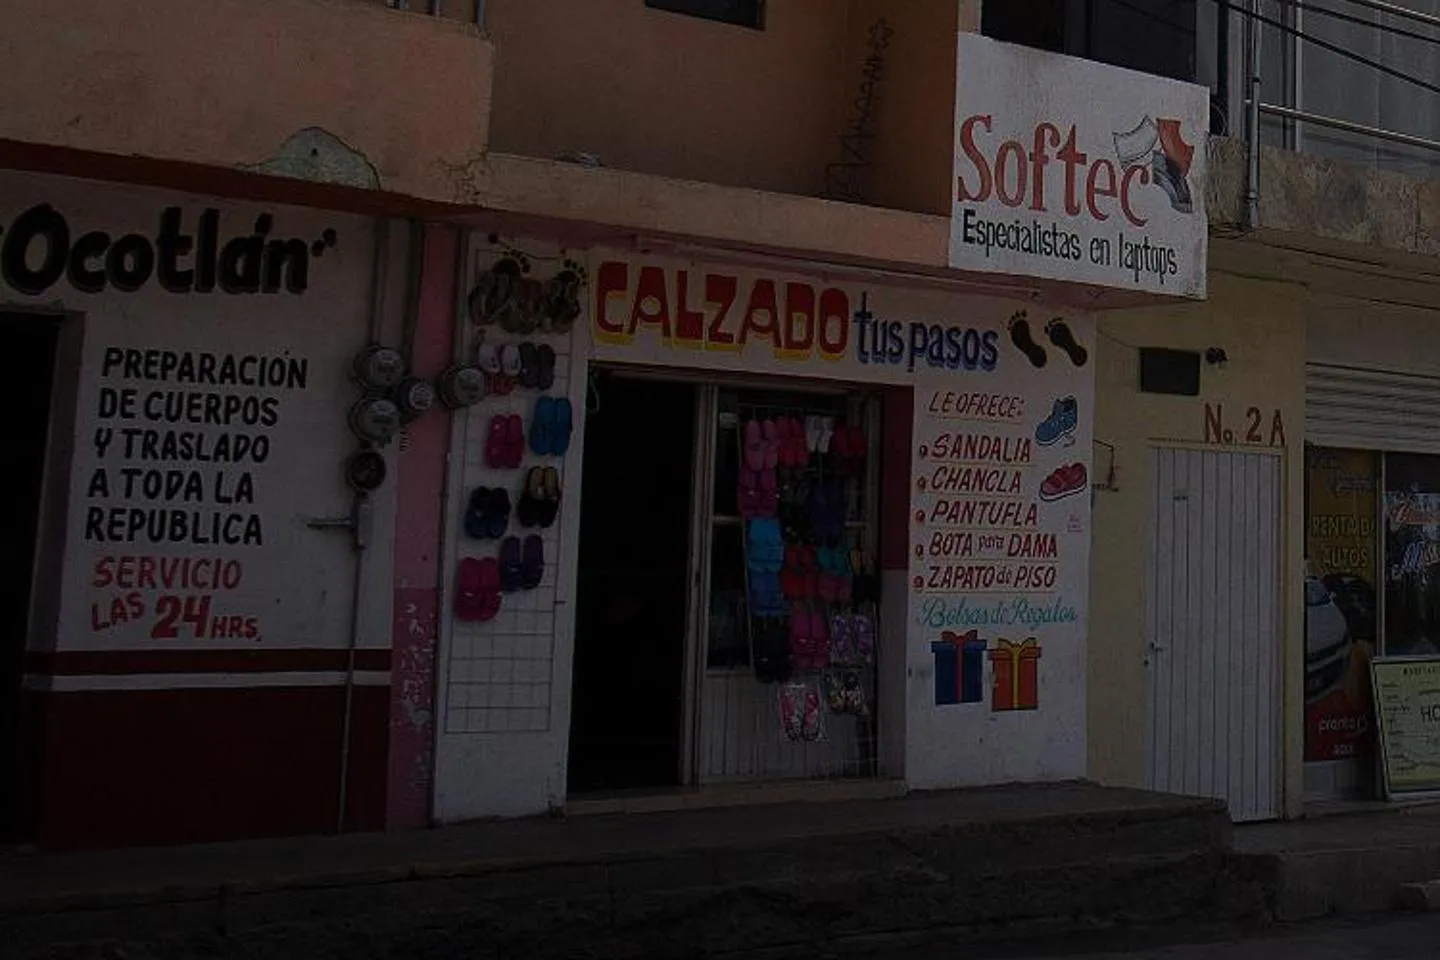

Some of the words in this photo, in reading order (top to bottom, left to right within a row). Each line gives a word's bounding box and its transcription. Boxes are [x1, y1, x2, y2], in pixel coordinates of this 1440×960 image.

[957, 114, 1150, 228] Softec
[963, 209, 1082, 260] Especialistas
[1089, 237, 1111, 266] en
[1118, 233, 1178, 285] laptops
[595, 261, 850, 358] CALZADO
[853, 291, 905, 364] tus
[907, 322, 1000, 373] pasos
[101, 347, 309, 389] PREPARACION
[98, 387, 138, 419] DE
[144, 390, 280, 427] CUERPOS
[928, 390, 955, 413] LE
[94, 428, 112, 458] Y
[121, 428, 270, 463] TRASLADO
[931, 433, 1032, 463] SANDALIA
[87, 468, 109, 498] A
[120, 468, 203, 502] TODA
[214, 471, 254, 504] LA
[930, 466, 1022, 494] CHANCLA
[85, 506, 263, 546] REPUBLICA
[930, 499, 1039, 526] PANTUFLA
[928, 531, 973, 557] BOTA
[1007, 533, 1058, 558] DAMA
[92, 555, 244, 590] SERVICIO
[927, 565, 996, 589] ZAPATO
[1013, 565, 1057, 589] PISO
[91, 591, 145, 632] LAS
[151, 595, 212, 639] 24
[916, 596, 989, 629] Bolsas
[1007, 595, 1079, 631] Regalos
